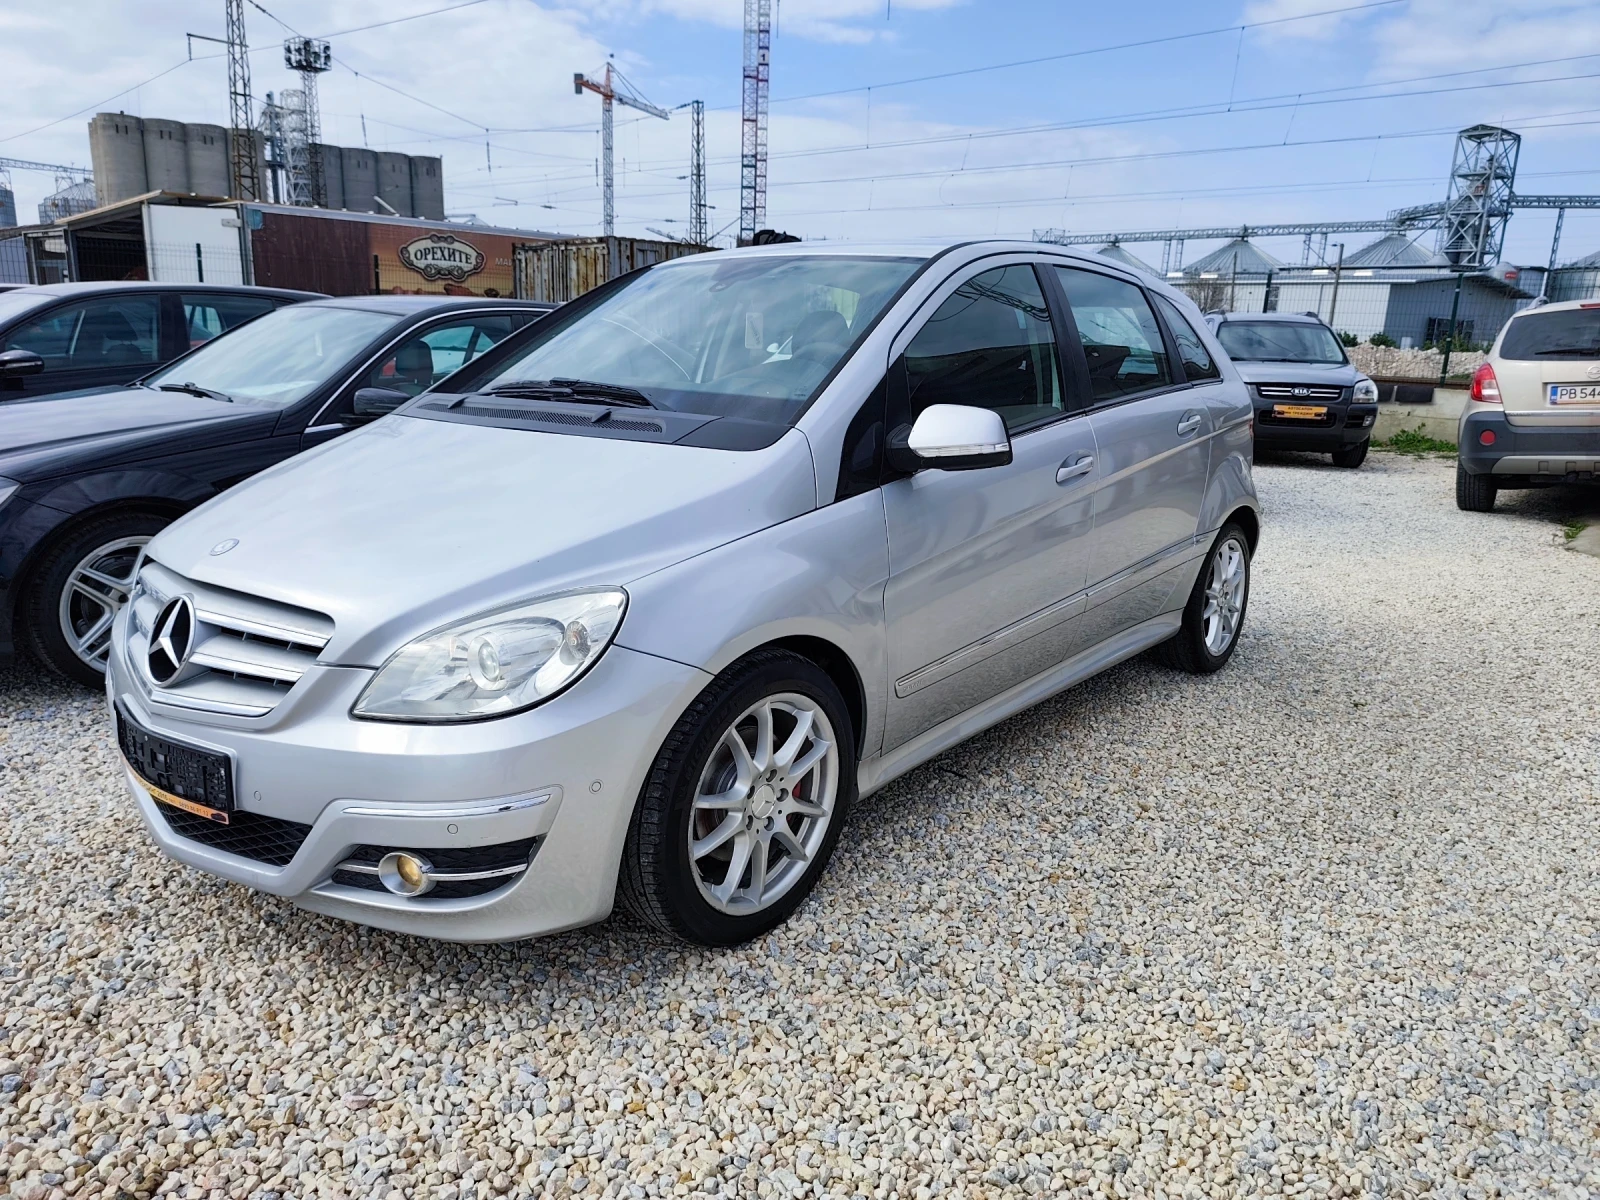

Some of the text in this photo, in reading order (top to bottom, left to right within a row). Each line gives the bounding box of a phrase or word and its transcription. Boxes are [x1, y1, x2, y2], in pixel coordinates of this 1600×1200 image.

[760, 53, 766, 61] 1
[414, 246, 473, 265] ОРЕХИТЕ
[1559, 388, 1577, 399] PB
